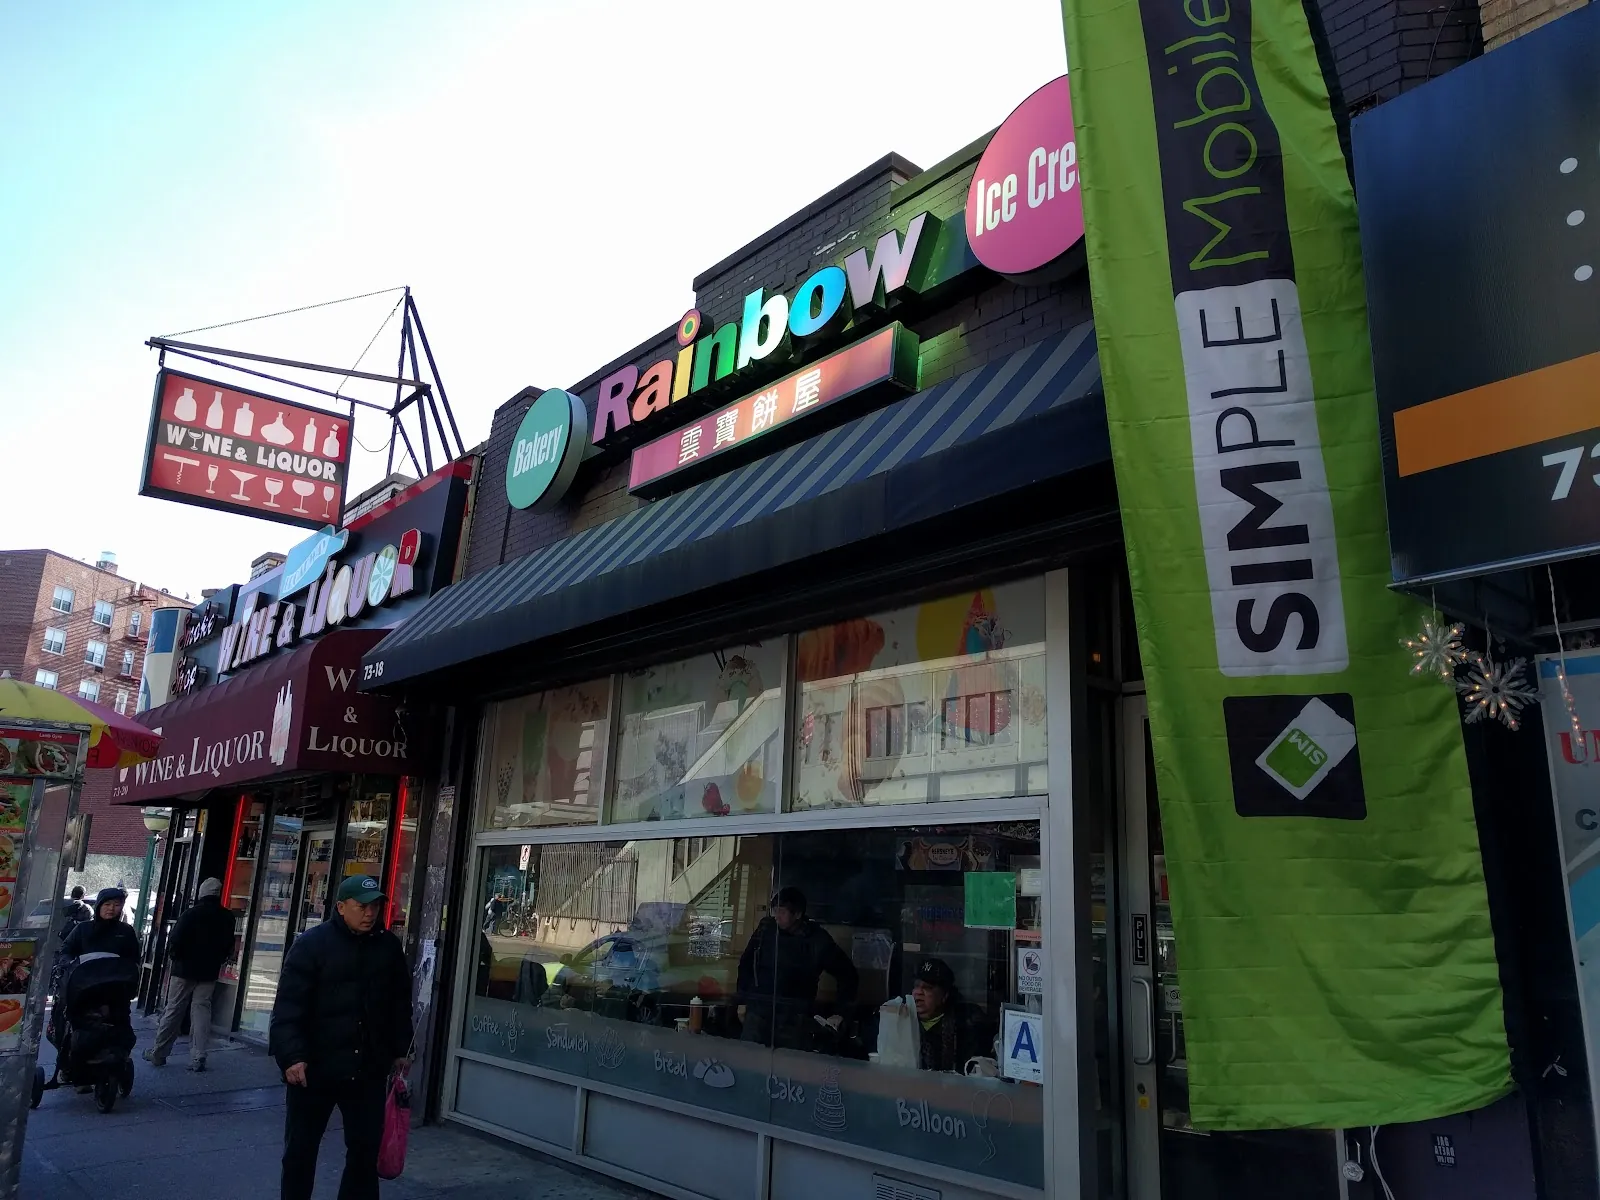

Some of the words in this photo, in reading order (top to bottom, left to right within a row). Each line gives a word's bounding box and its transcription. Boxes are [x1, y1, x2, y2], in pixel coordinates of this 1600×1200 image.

[1164, 0, 1270, 271] Mobile
[975, 173, 1018, 237] Ice
[1027, 141, 1080, 209] Cre
[592, 211, 931, 444] Rainbow
[677, 368, 822, 465] 雲寶餅屋
[234, 447, 248, 462] &
[256, 446, 336, 482] LIQUOR
[512, 424, 563, 478] Bakery
[1198, 298, 1320, 653] SIMPLE
[277, 602, 298, 648] &
[299, 528, 422, 639] LIQUOR
[363, 660, 385, 681] 73-18
[343, 706, 358, 724] &
[134, 754, 175, 787] WINE
[176, 760, 185, 779] &
[189, 730, 265, 778] LIQUOR
[307, 726, 407, 759] LIQUOR
[1287, 730, 1325, 765] SIM
[1136, 920, 1145, 959] PULL
[471, 1015, 500, 1035] Coffee
[546, 1029, 589, 1052] Sandwich
[1010, 1021, 1038, 1064] A
[654, 1052, 688, 1080] Bread
[765, 1074, 805, 1104] Cake
[896, 1097, 967, 1140] Balloon
